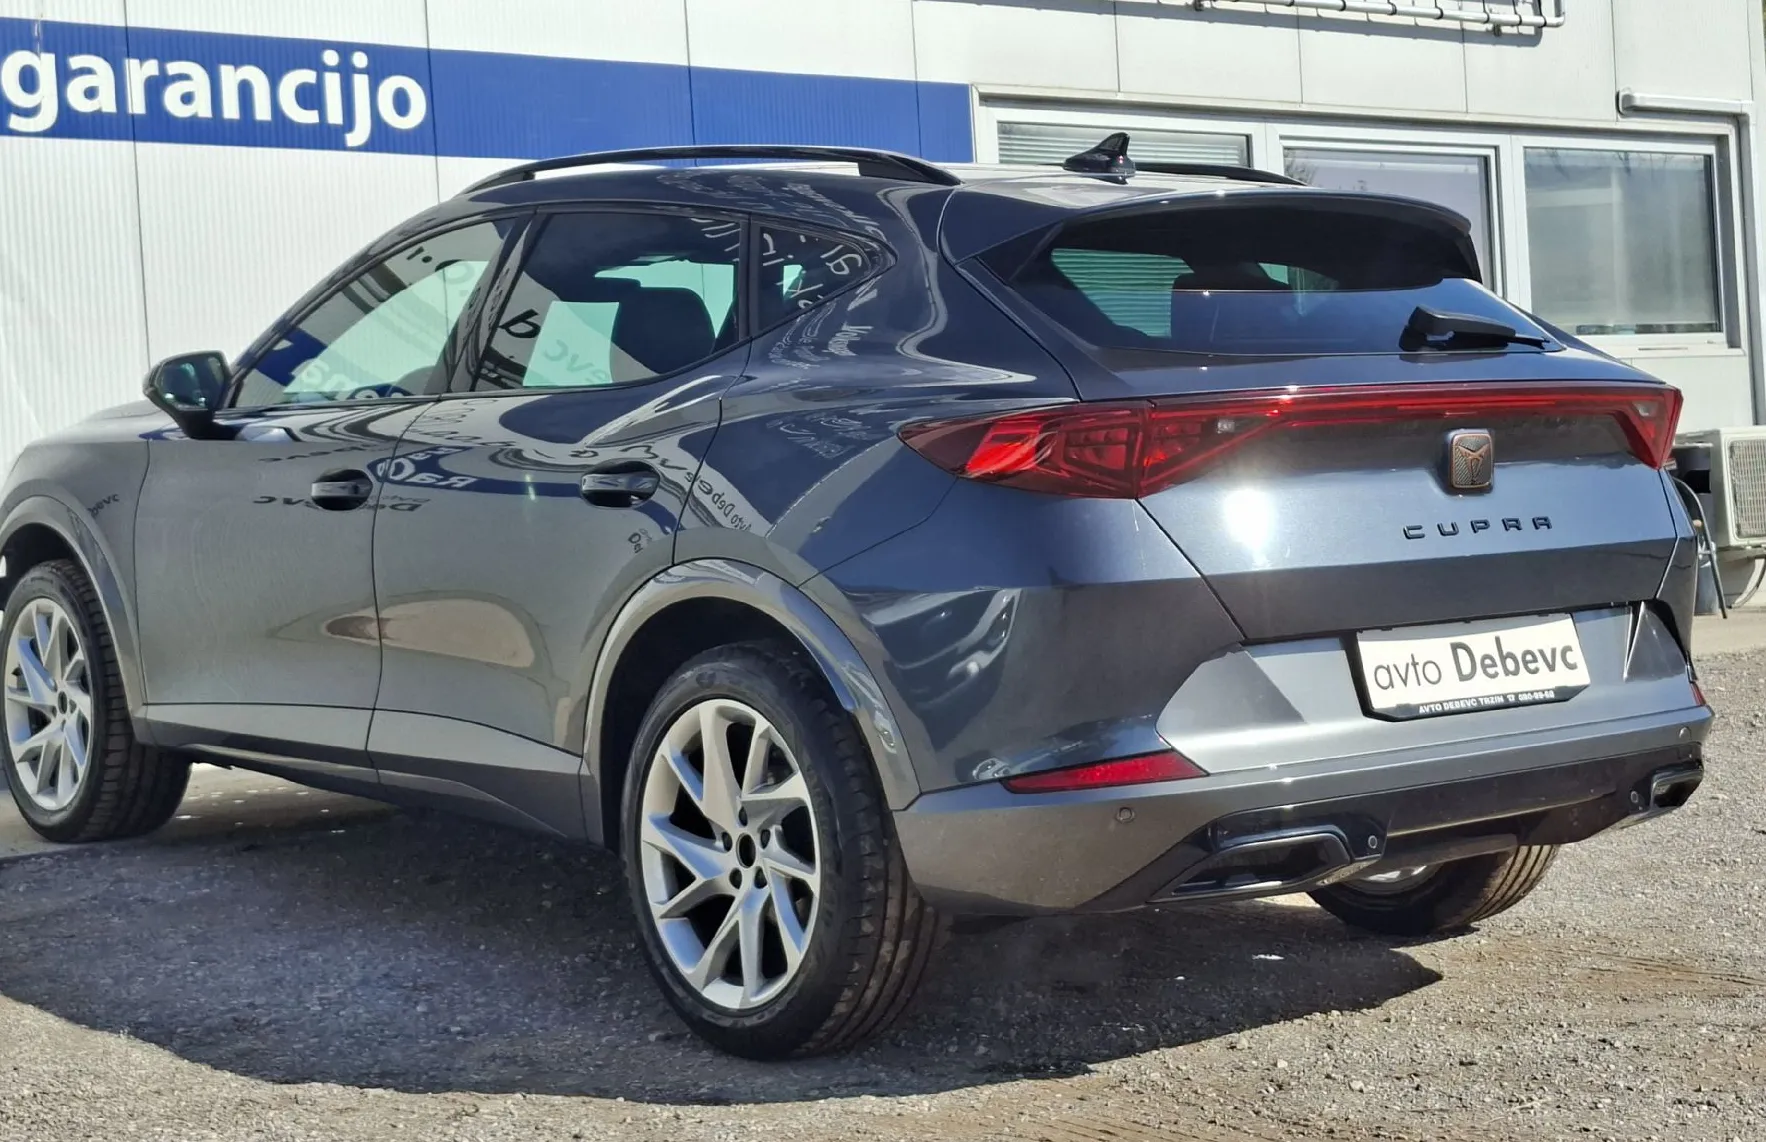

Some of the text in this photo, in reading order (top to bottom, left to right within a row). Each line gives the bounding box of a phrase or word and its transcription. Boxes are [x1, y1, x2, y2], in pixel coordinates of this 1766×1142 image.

[0, 49, 427, 147] garancijo
[1403, 516, 1553, 540] CUPRA
[1374, 636, 1578, 690] avto Debevc
[1419, 703, 1441, 715] AVTO
[1443, 698, 1478, 711] DEBEVC
[1479, 695, 1504, 707] TRZIN
